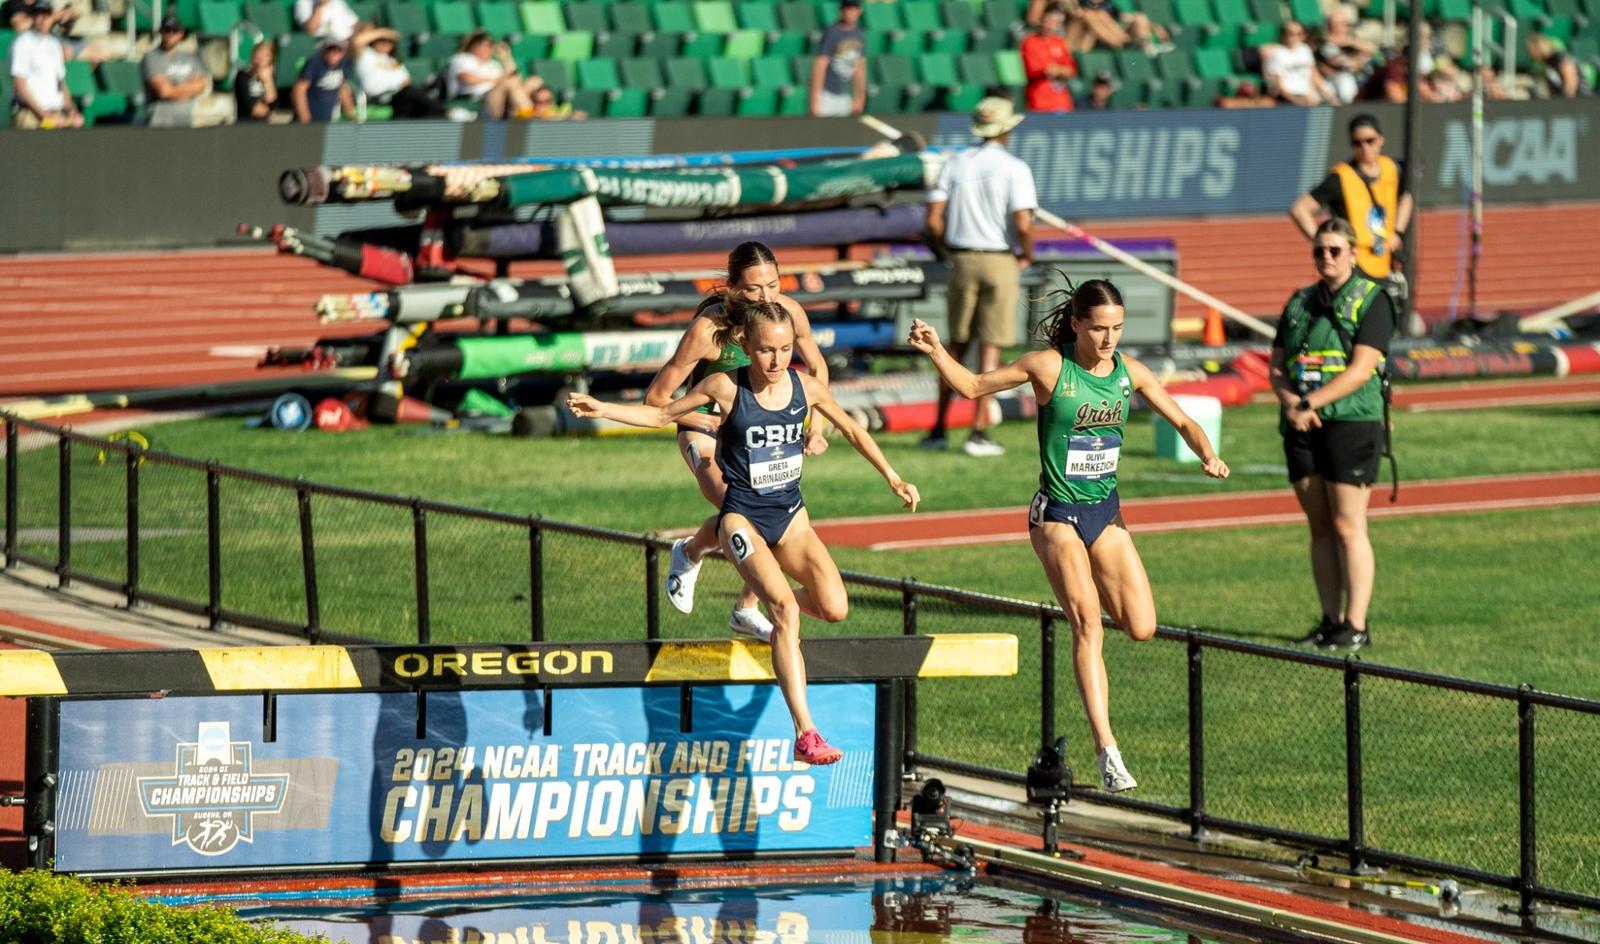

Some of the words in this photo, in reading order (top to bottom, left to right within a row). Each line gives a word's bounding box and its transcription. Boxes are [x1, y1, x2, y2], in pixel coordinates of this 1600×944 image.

[1437, 117, 1577, 188] NCAA
[1008, 127, 1241, 203] ONSHIPS
[1073, 400, 1124, 432] Irish
[746, 422, 804, 449] CBU
[768, 461, 789, 472] GRETA
[1070, 459, 1116, 473] MARKEZICH
[1085, 452, 1106, 461] OLIVIA
[752, 466, 801, 487] KARINAUSKAITE
[731, 532, 747, 560] 9
[393, 649, 614, 678] OREGON
[198, 765, 218, 774] 2024
[391, 747, 476, 782] 2024
[481, 744, 559, 780] NCAA
[573, 741, 667, 777] TRACK
[669, 740, 732, 774] AND
[734, 738, 812, 772] FIEL
[178, 775, 210, 787] TRACK
[211, 774, 220, 786] &
[222, 773, 249, 786] FIELD
[151, 785, 276, 806] CHAMPIONSHIPS
[222, 811, 233, 820] OR
[380, 774, 816, 844] CHAMPIONSHIPS
